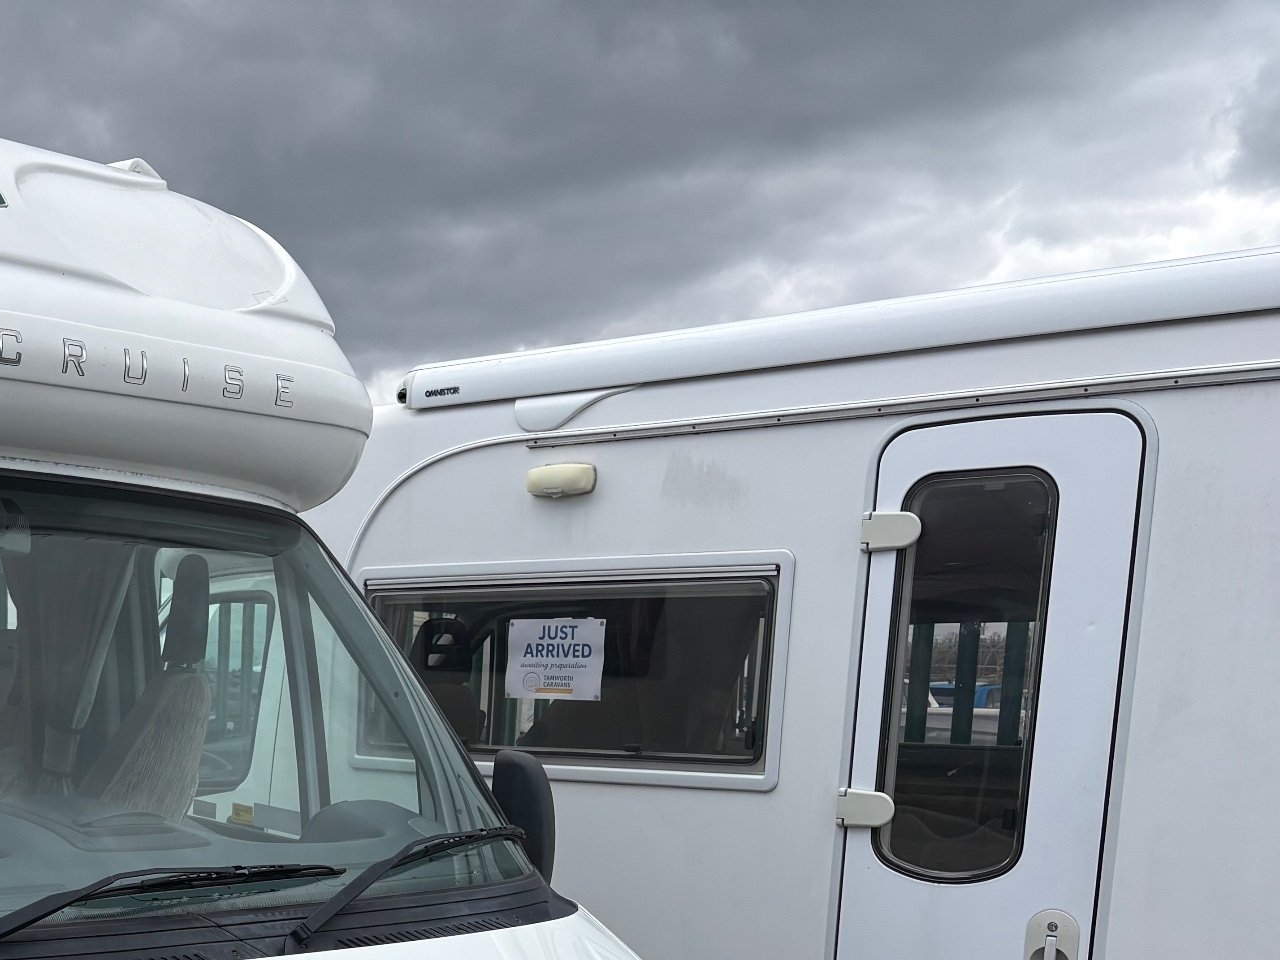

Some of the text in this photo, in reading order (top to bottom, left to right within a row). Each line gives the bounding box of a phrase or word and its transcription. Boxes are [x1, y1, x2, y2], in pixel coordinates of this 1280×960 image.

[538, 625, 578, 640] JUST
[523, 643, 592, 658] ARRIVED
[549, 662, 587, 671] preparation
